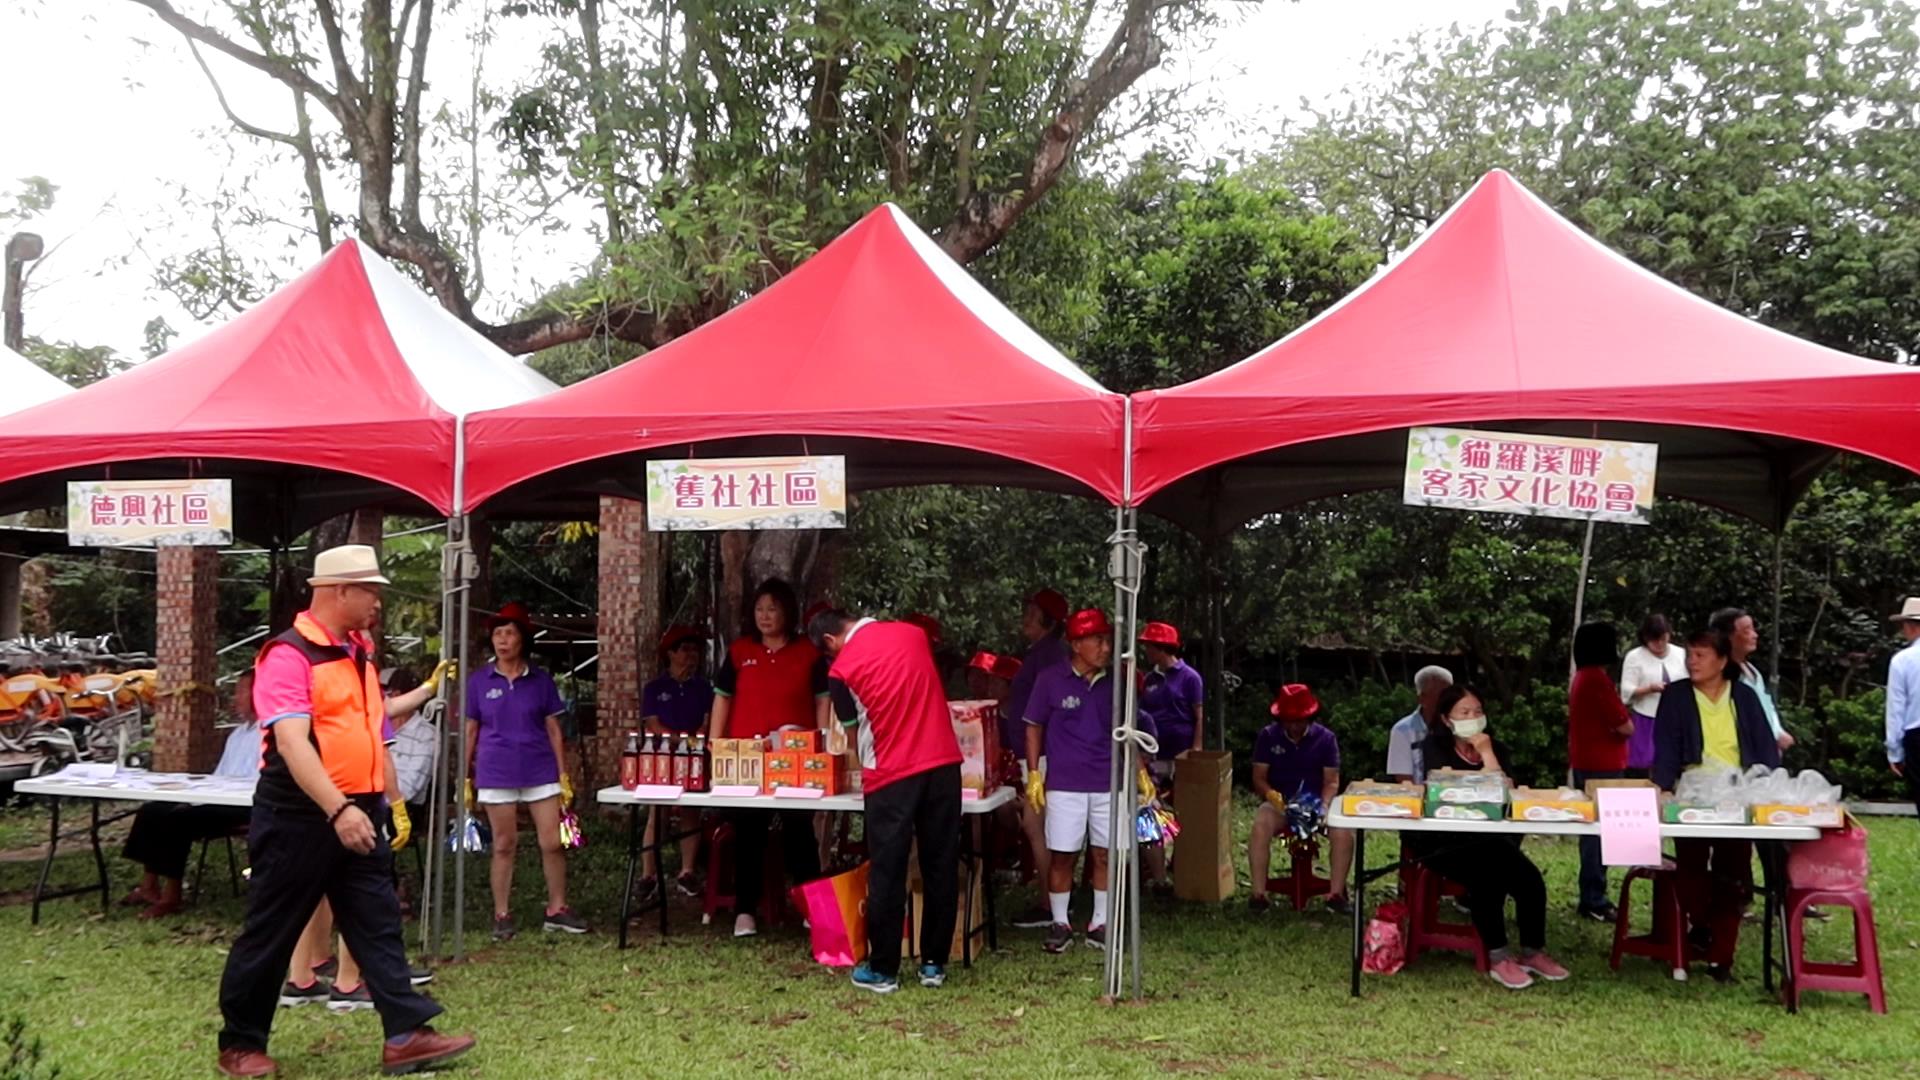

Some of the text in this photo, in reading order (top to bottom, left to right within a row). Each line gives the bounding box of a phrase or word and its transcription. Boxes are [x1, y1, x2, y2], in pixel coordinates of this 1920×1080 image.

[1460, 439, 1603, 477] 貓羅溪畔
[674, 472, 818, 508] 舊社社區
[1422, 468, 1636, 512] 客家文化協會
[90, 493, 209, 526] 德興社區
